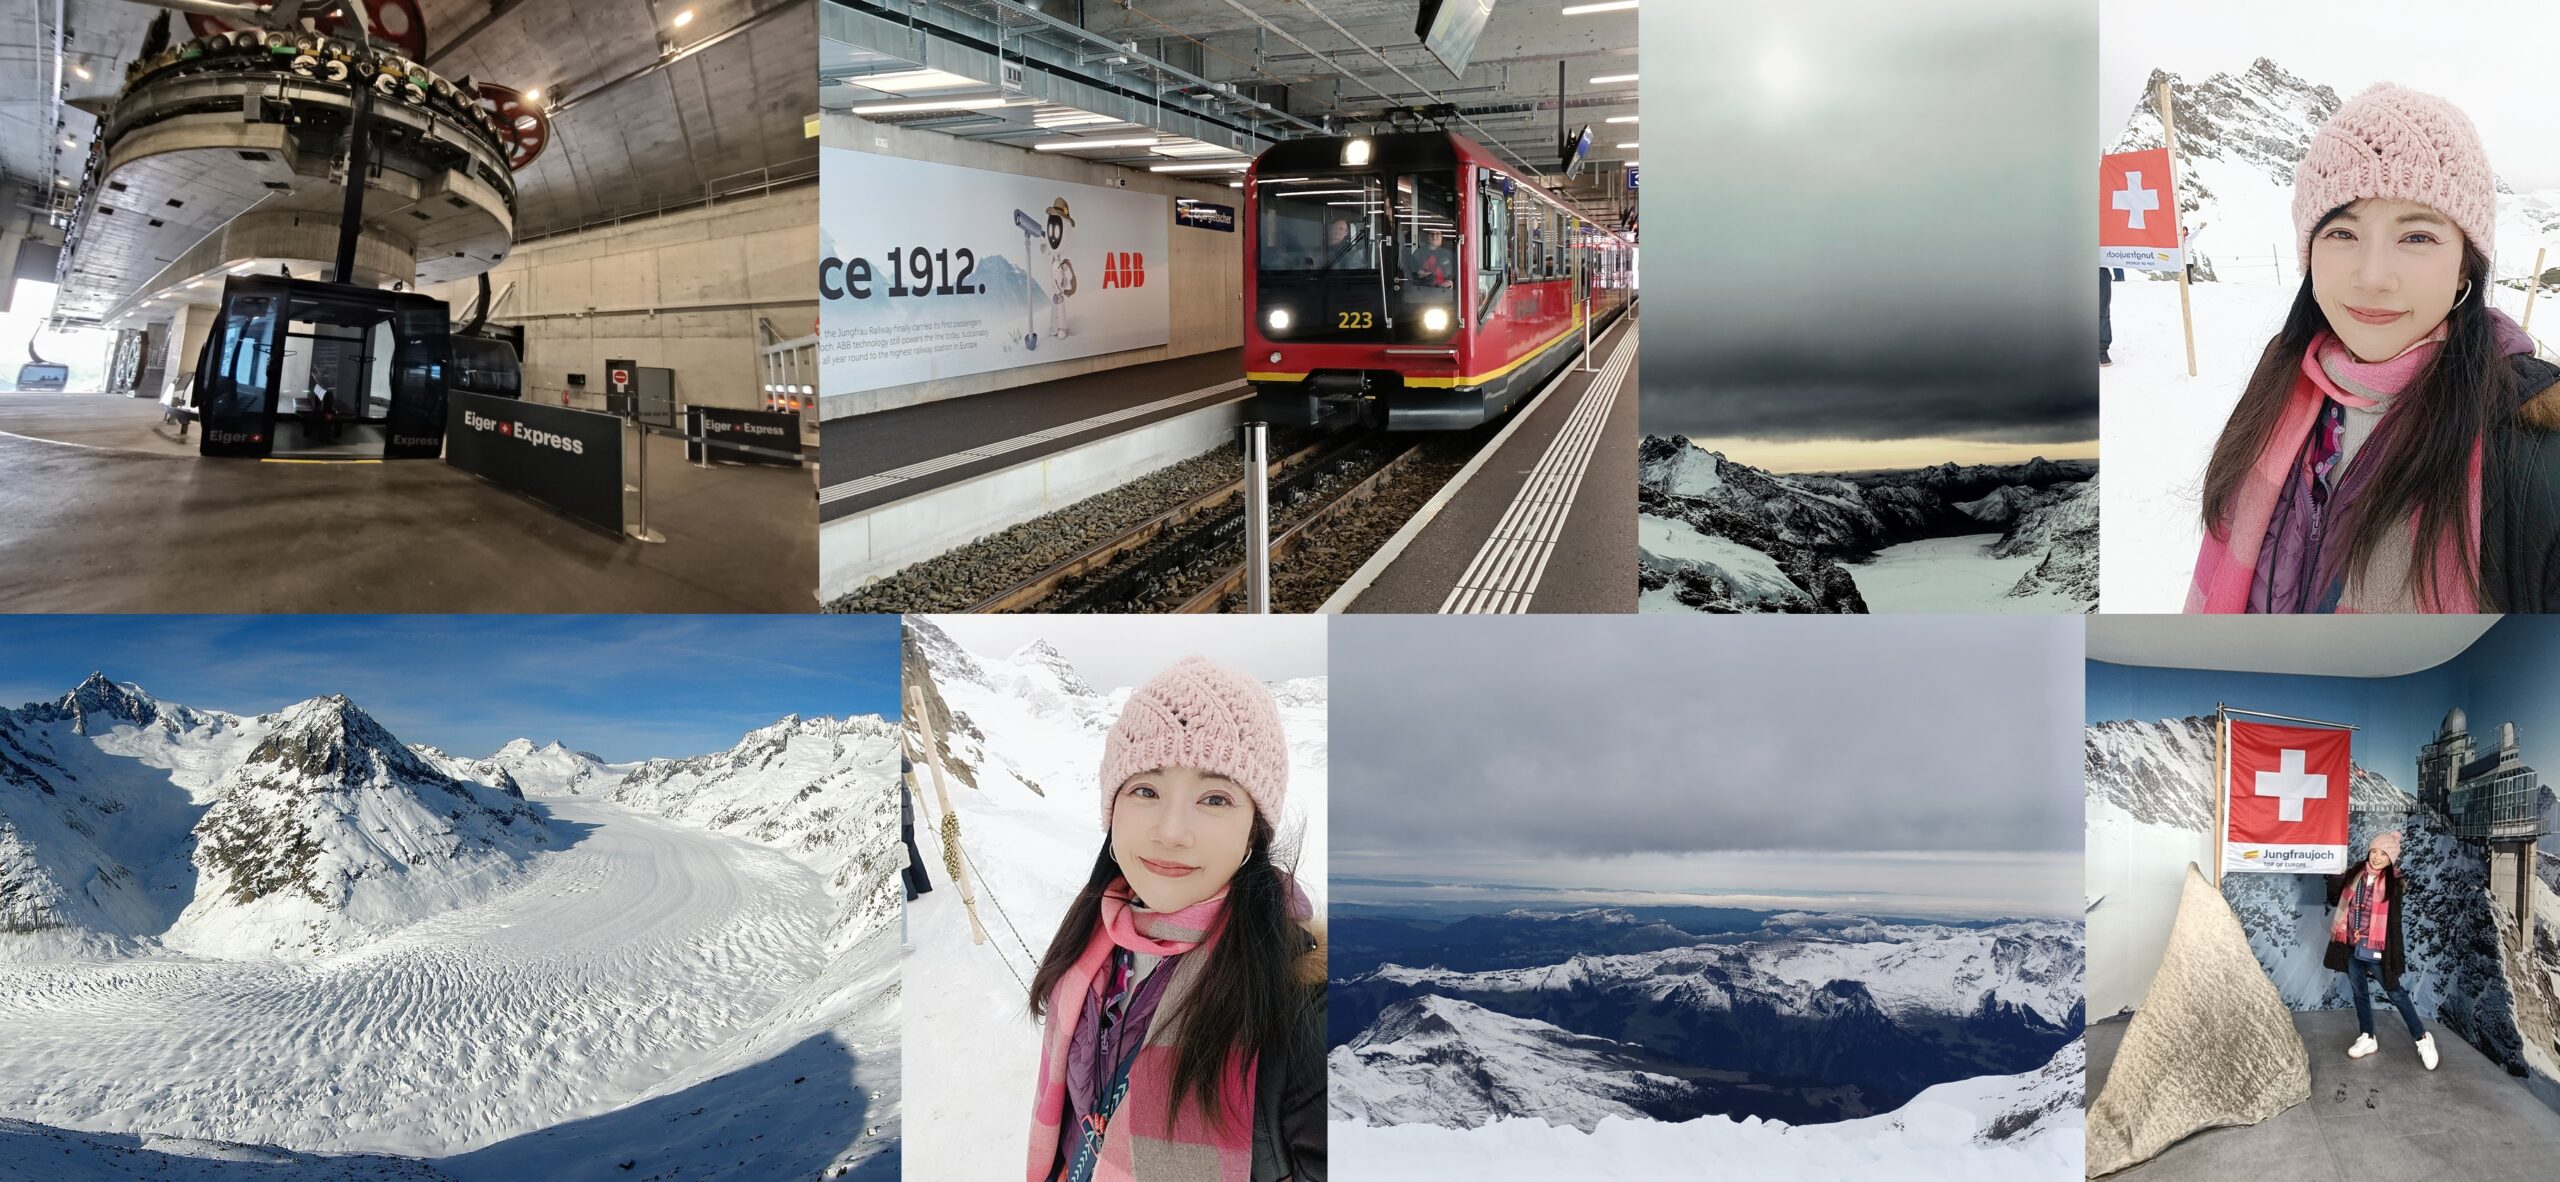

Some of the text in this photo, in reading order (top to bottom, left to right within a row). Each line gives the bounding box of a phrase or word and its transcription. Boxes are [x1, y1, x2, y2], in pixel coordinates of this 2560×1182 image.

[819, 246, 986, 300] ce 1912.
[1103, 252, 1145, 289] ABB
[824, 329, 836, 338] the
[837, 326, 868, 339] Jungfrau
[869, 325, 892, 336] Railway
[893, 322, 910, 333] finally
[912, 322, 932, 331] carried
[941, 320, 953, 329] first
[953, 319, 982, 329] passengers
[1338, 311, 1373, 329] 223
[836, 340, 851, 351] ABB
[852, 338, 889, 350] technology
[890, 335, 900, 346] still
[901, 334, 923, 345] powers
[924, 333, 933, 342] the
[934, 332, 944, 341] line
[961, 328, 989, 340] sustainably
[822, 355, 831, 365] all
[832, 355, 847, 366] year
[848, 351, 868, 362] round
[869, 352, 877, 360] to
[878, 349, 889, 359] the
[889, 347, 912, 359] highest
[913, 345, 933, 356] railway
[934, 343, 952, 353] station
[953, 341, 959, 350] in
[209, 429, 249, 443] Eiger
[464, 410, 583, 455] Eiger Express
[705, 419, 784, 436] Eiger Express
[393, 434, 440, 447] Express
[2263, 849, 2334, 860] Jungfraujoch
